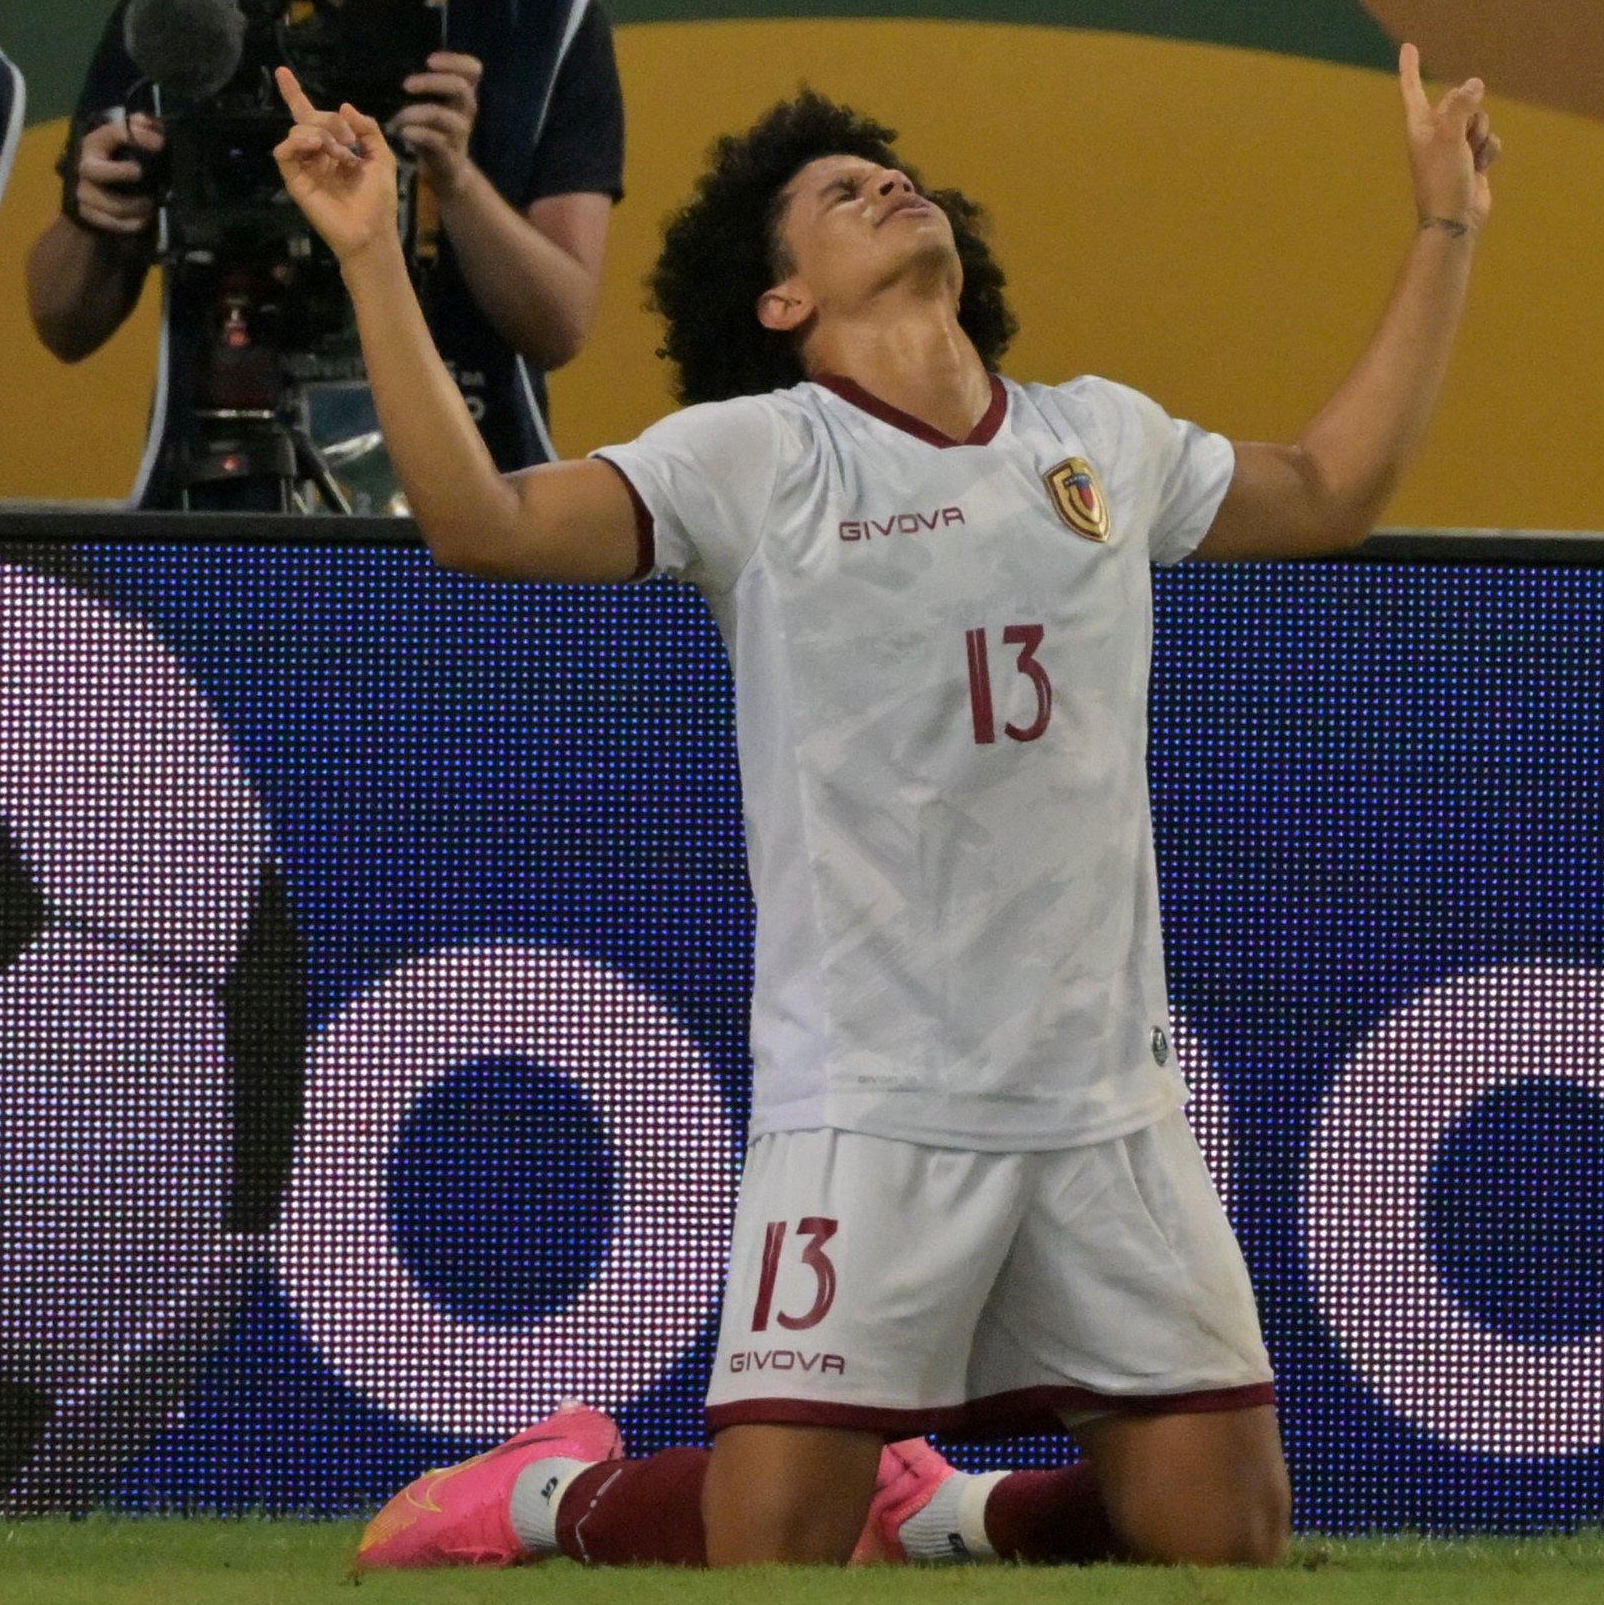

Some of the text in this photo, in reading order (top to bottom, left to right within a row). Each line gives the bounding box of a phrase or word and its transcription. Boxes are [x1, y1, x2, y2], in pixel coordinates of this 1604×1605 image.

[838, 506, 966, 543] GIVOVA
[965, 623, 1053, 744] 13
[751, 1217, 840, 1333] 13
[729, 1350, 846, 1376] GIVOVA
